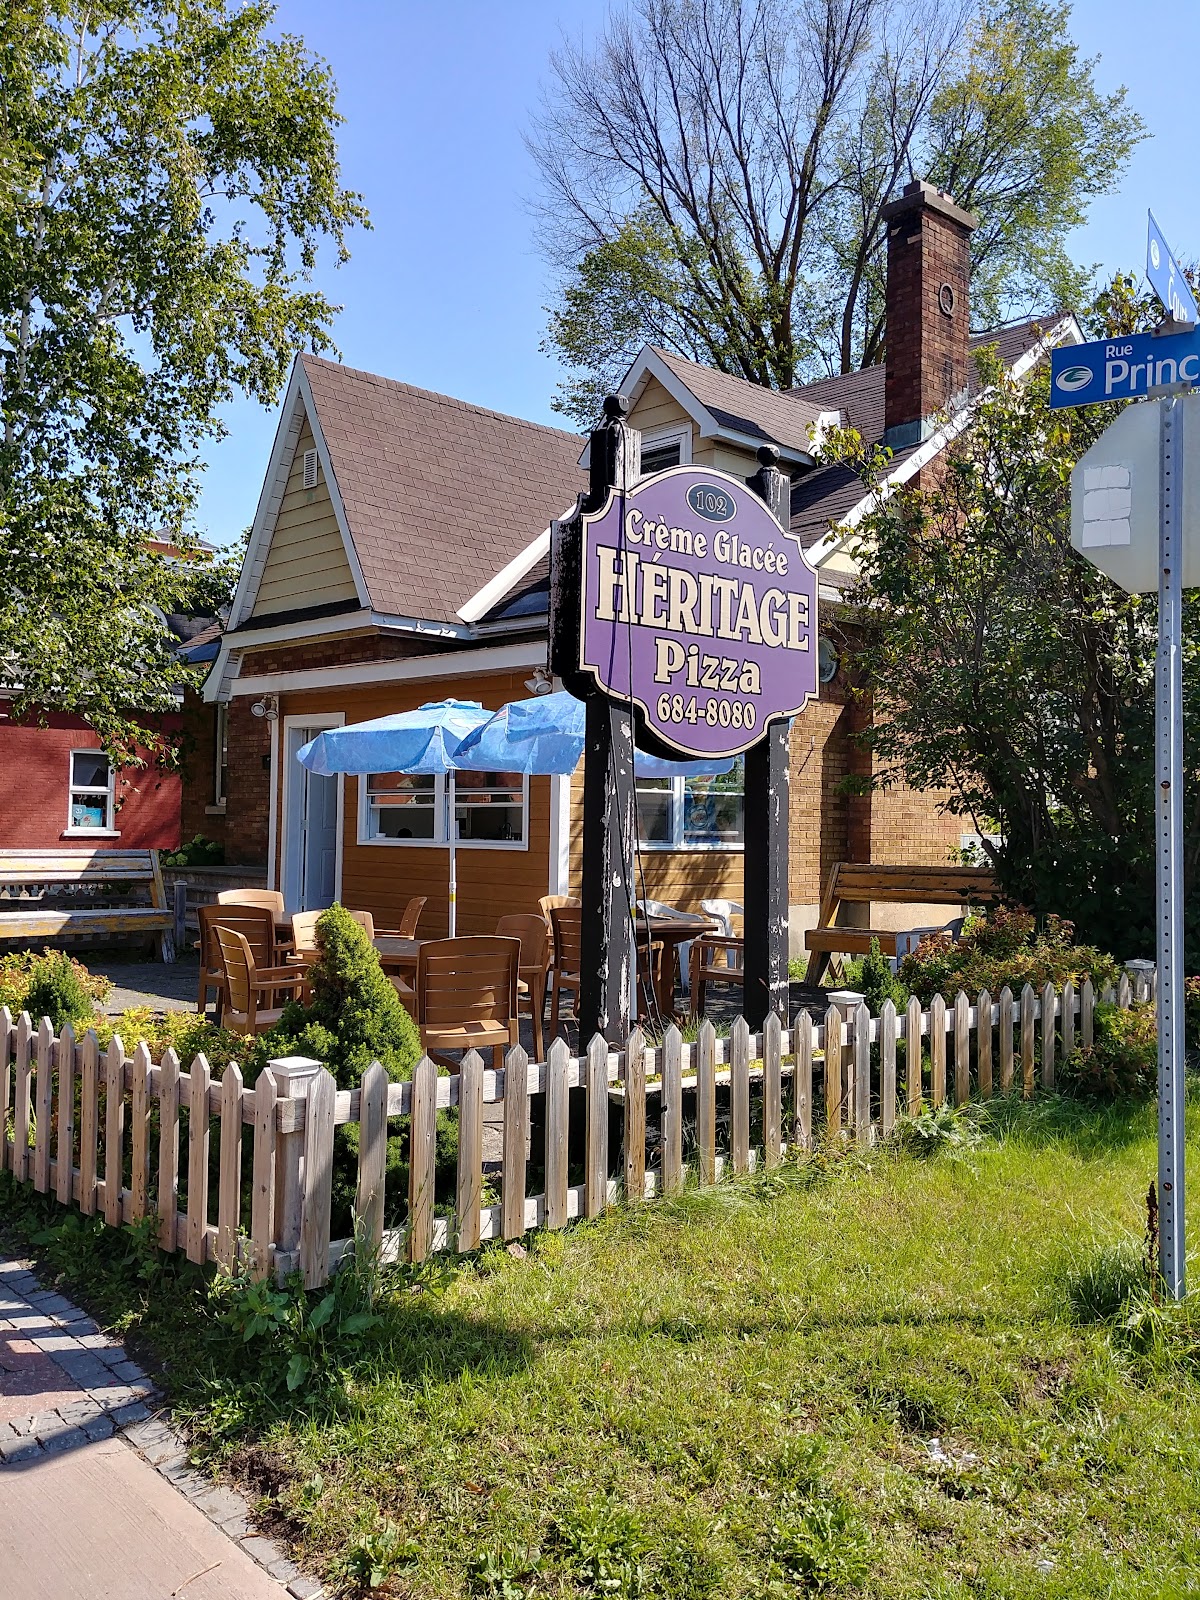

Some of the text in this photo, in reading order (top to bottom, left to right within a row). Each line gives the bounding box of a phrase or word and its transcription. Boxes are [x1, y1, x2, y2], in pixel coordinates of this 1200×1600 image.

[1105, 344, 1133, 359] Rue
[1104, 354, 1200, 395] Princ
[696, 491, 728, 517] 102
[625, 508, 789, 577] Crème Glacée
[595, 543, 811, 652] HÉRITAGE
[654, 636, 762, 695] Pizza
[657, 692, 756, 730] 684-8080
